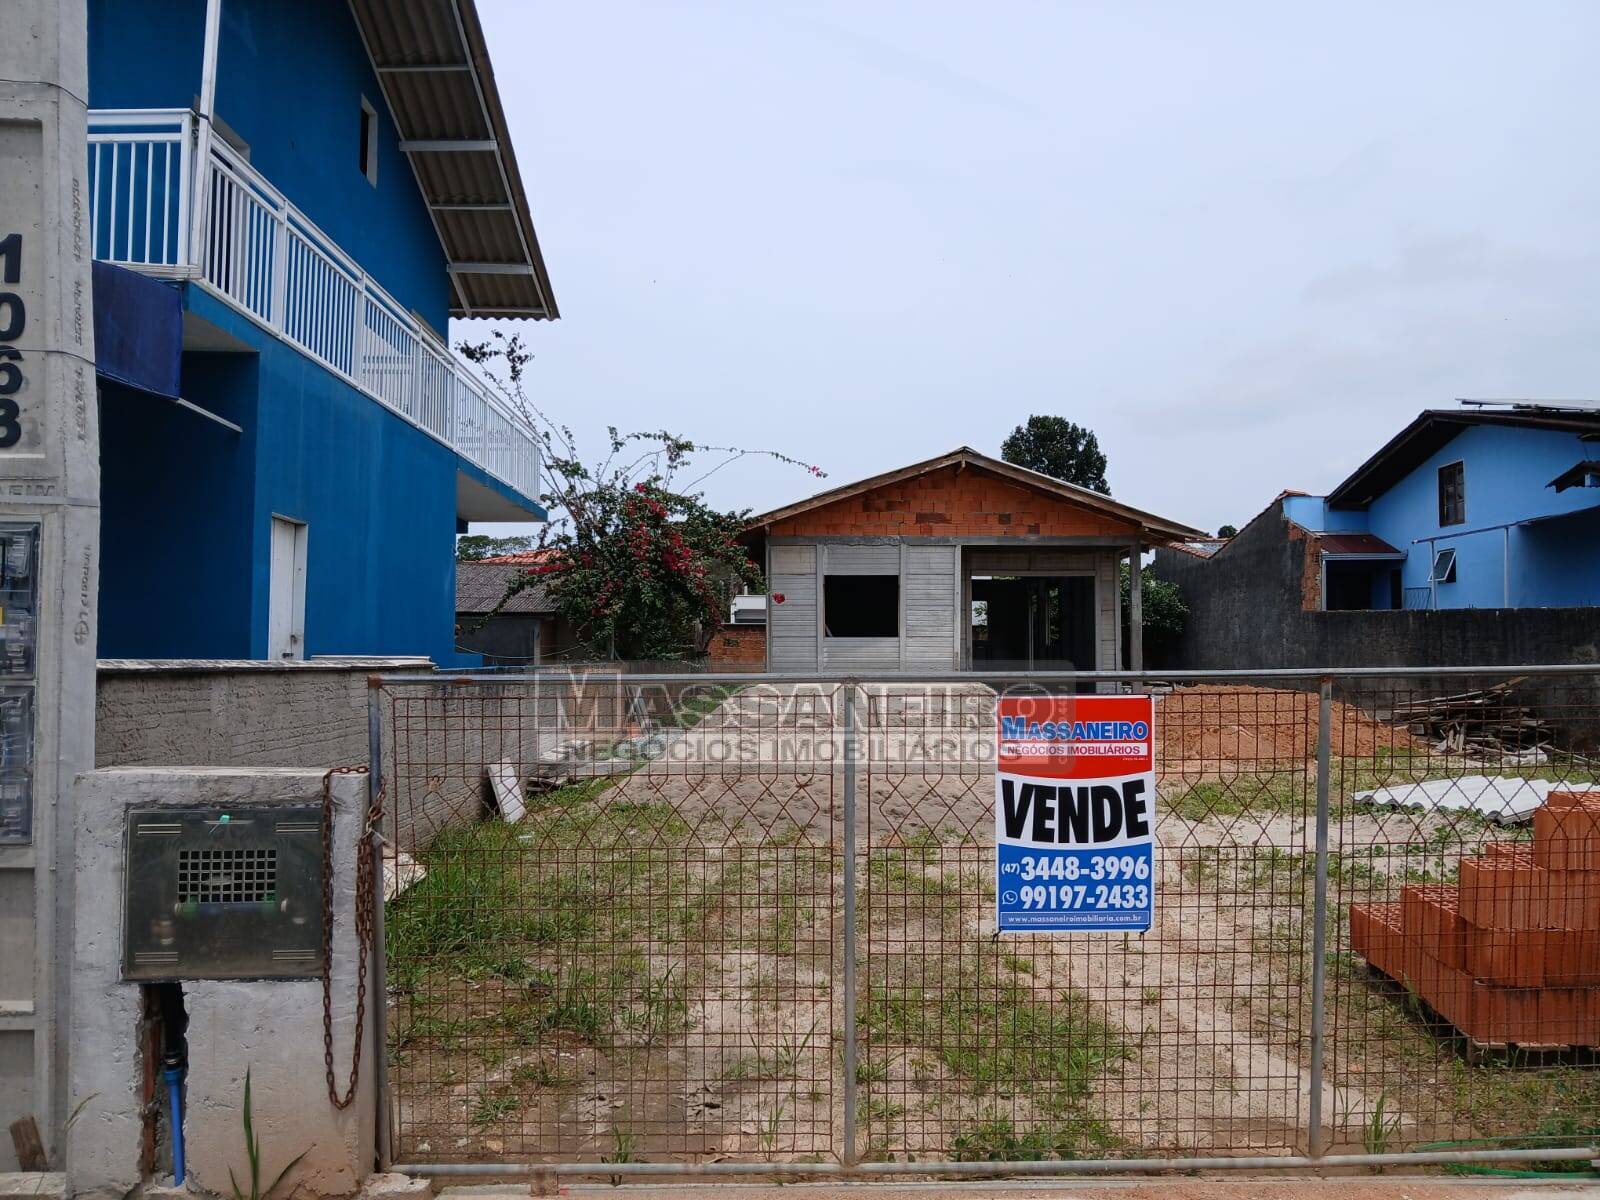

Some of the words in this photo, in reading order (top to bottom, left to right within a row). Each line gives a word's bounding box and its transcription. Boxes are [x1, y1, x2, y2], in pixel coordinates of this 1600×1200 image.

[1000, 715, 1148, 741] MASSANEIRO
[1007, 743, 1065, 755] NEGÓCIOS
[1067, 743, 1140, 755] IMOBILIÁRIOS
[1001, 778, 1149, 844] VENDE
[1001, 862, 1020, 875] (47)
[1020, 855, 1149, 881] 3448-3996
[1020, 885, 1148, 909] 99197-2433
[1008, 914, 1142, 924] www.massaneiroimobiliaria.com.br
